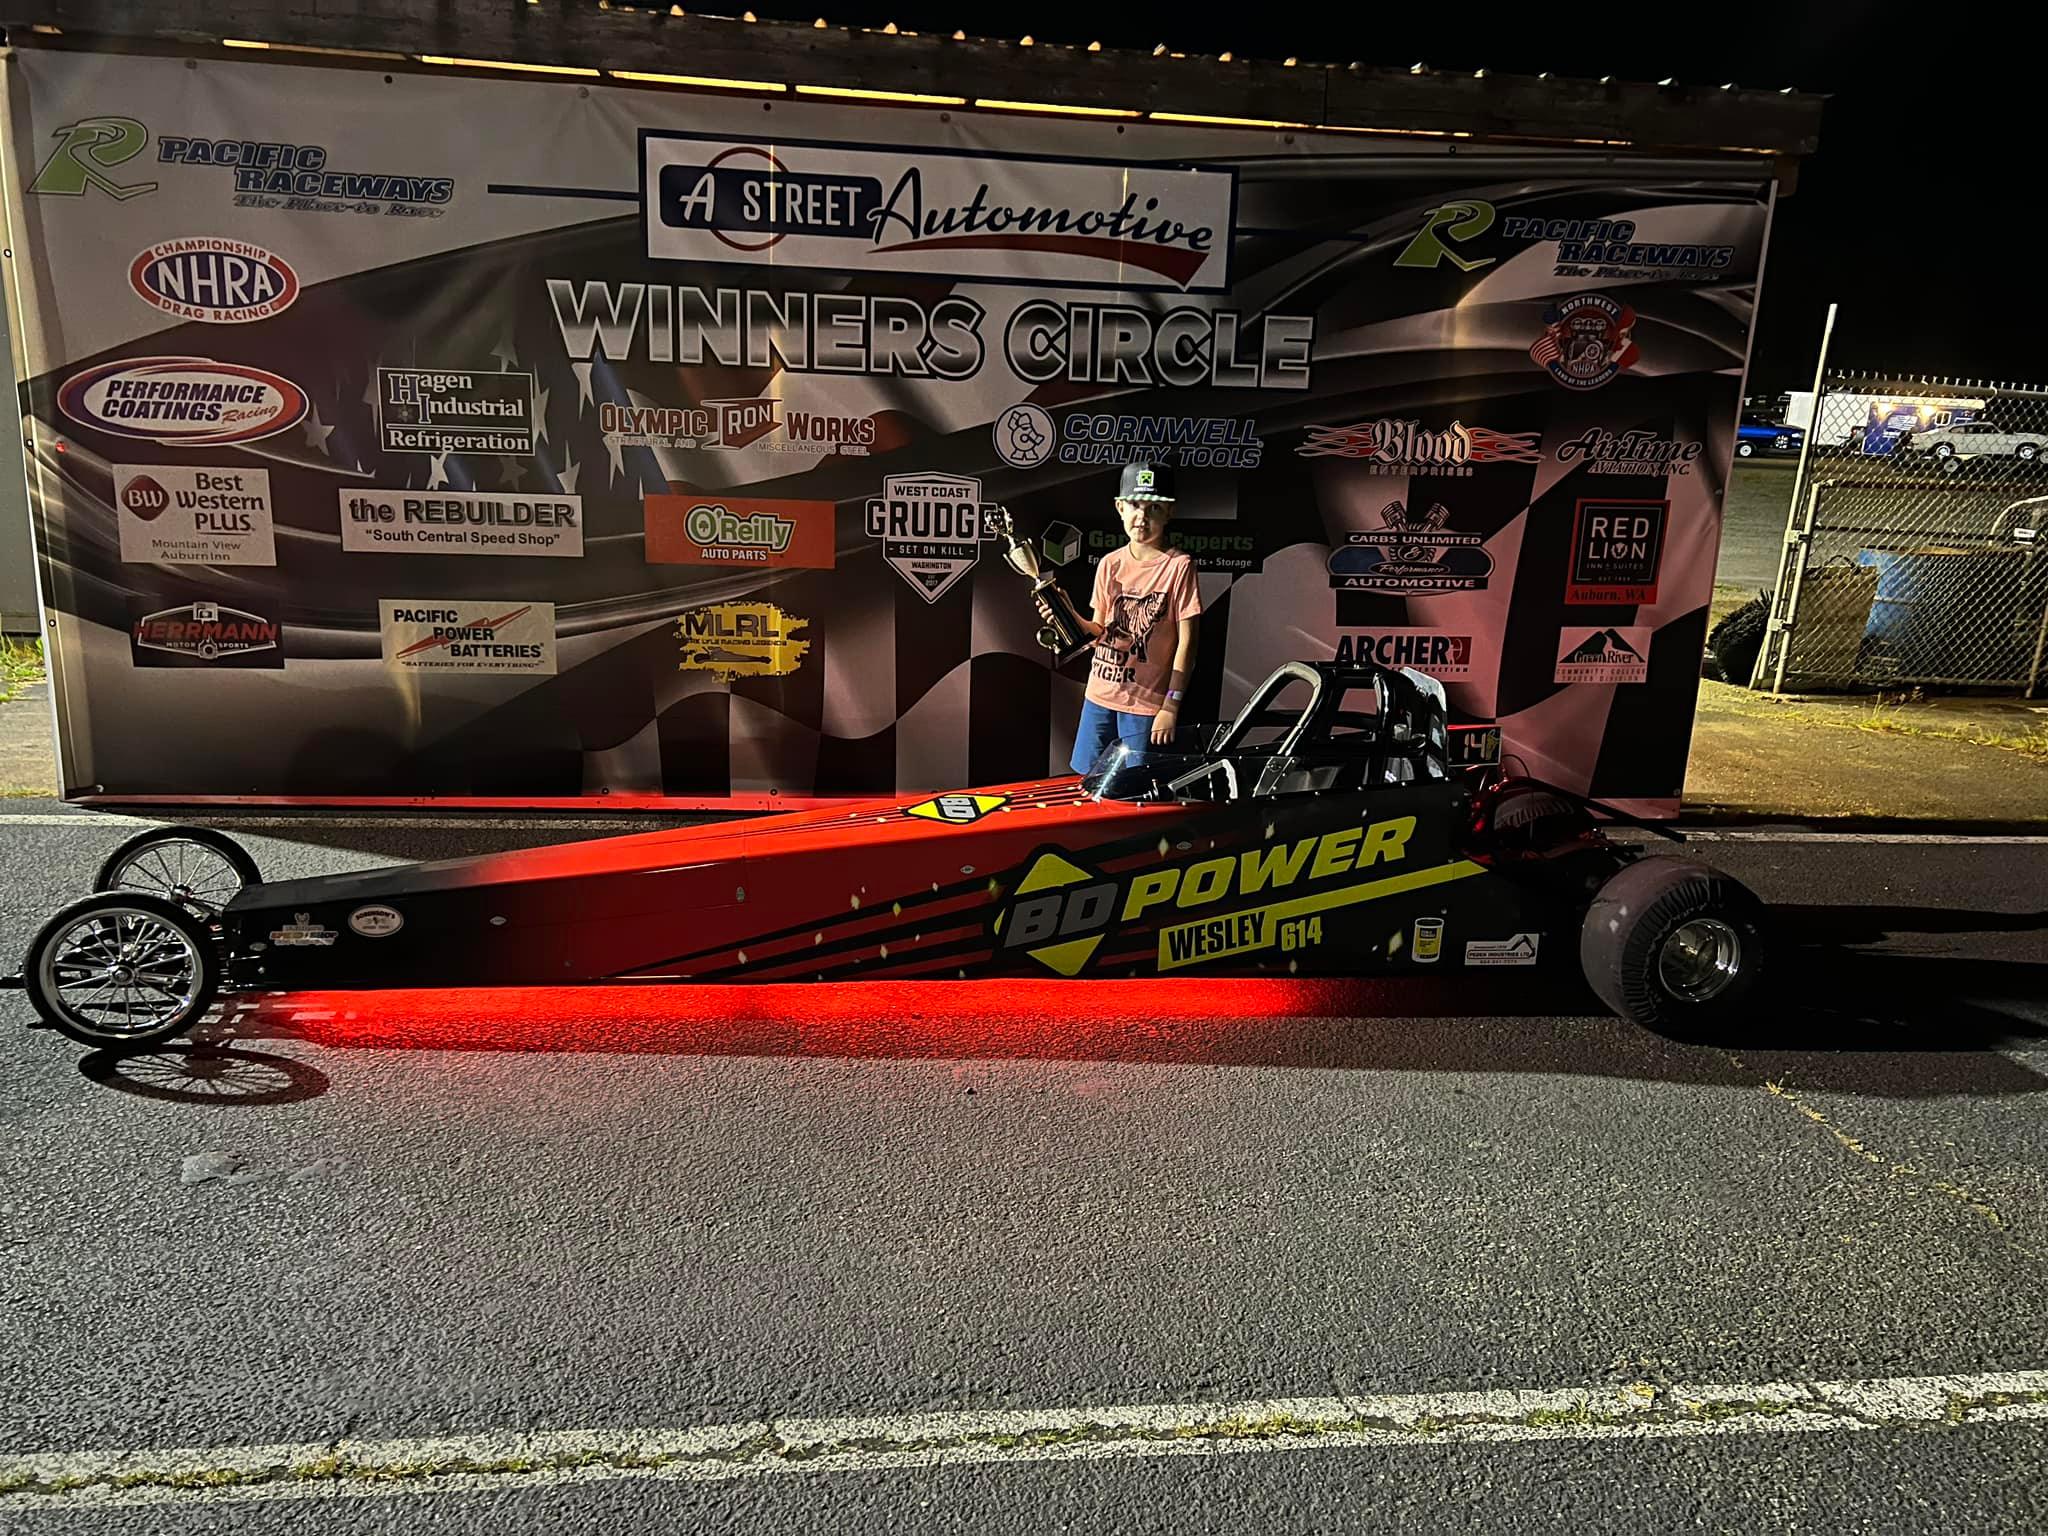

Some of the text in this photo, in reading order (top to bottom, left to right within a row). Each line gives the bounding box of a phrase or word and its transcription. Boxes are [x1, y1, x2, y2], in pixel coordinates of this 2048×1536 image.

[158, 136, 326, 170] PACIFIC
[234, 166, 455, 203] RACEWAYS
[679, 167, 1213, 251] A STREET Automotive
[1503, 217, 1636, 242] PACIFIC
[154, 239, 267, 261] CHAMPIONSHIP
[1557, 241, 1734, 268] RACEWAYS
[157, 255, 275, 306] NHRA
[161, 300, 272, 321] DRAG RACING
[1561, 296, 1618, 315] NORTHWEST
[546, 277, 1315, 389] WINNERS CIRCLE
[105, 379, 267, 404] PERFORMANCE
[388, 372, 472, 404] Hagen
[101, 399, 279, 425] COATINGS Racing
[417, 393, 524, 424] Industrial
[600, 402, 709, 437] OLYMPIC
[786, 410, 876, 444] WORKS
[1064, 413, 1259, 446] CORNWELL
[389, 430, 530, 452] Refrigeration
[609, 436, 697, 449] STRUCTURAL AND
[758, 442, 870, 456] MISCELLANEOUS STEEL
[1369, 419, 1472, 466] Blood
[1556, 427, 1702, 463] AirTime
[1060, 443, 1262, 469] QUALITY TOOLS
[1369, 465, 1473, 477] ENTERPRISES
[1663, 463, 1690, 475] INC.
[195, 473, 243, 491] Best
[894, 485, 971, 498] WEST COAST
[128, 490, 163, 507] BW
[176, 491, 264, 511] Western
[195, 513, 252, 532] PLUS
[349, 498, 577, 528] the REBUILDER
[417, 530, 467, 543] Central
[470, 532, 516, 546] Speed
[687, 506, 793, 549] O'Reilly
[1591, 517, 1650, 539] RED
[152, 539, 241, 551] Mountain View
[900, 545, 964, 556] SET ON KILL
[1350, 535, 1481, 545] CARBS UNLIMITED
[1588, 542, 1646, 559] LION
[701, 548, 767, 561] AUTO PARTS
[911, 561, 952, 569] WASHINGTON
[1216, 557, 1253, 568] Storage
[1344, 578, 1476, 588] AUTOMOTIVE
[1625, 588, 1647, 601] WA
[393, 609, 458, 623] PACIFIC
[685, 614, 779, 637] MLRL
[133, 621, 277, 641] HERRMANN
[433, 626, 494, 641] POWER
[450, 644, 541, 659] BATTERIES
[1335, 635, 1450, 664] ARCHER
[1608, 650, 1635, 663] River
[1092, 661, 1136, 683] TIGER
[1003, 816, 1418, 948] BD POWER
[1168, 912, 1323, 964] WESLEY 614
